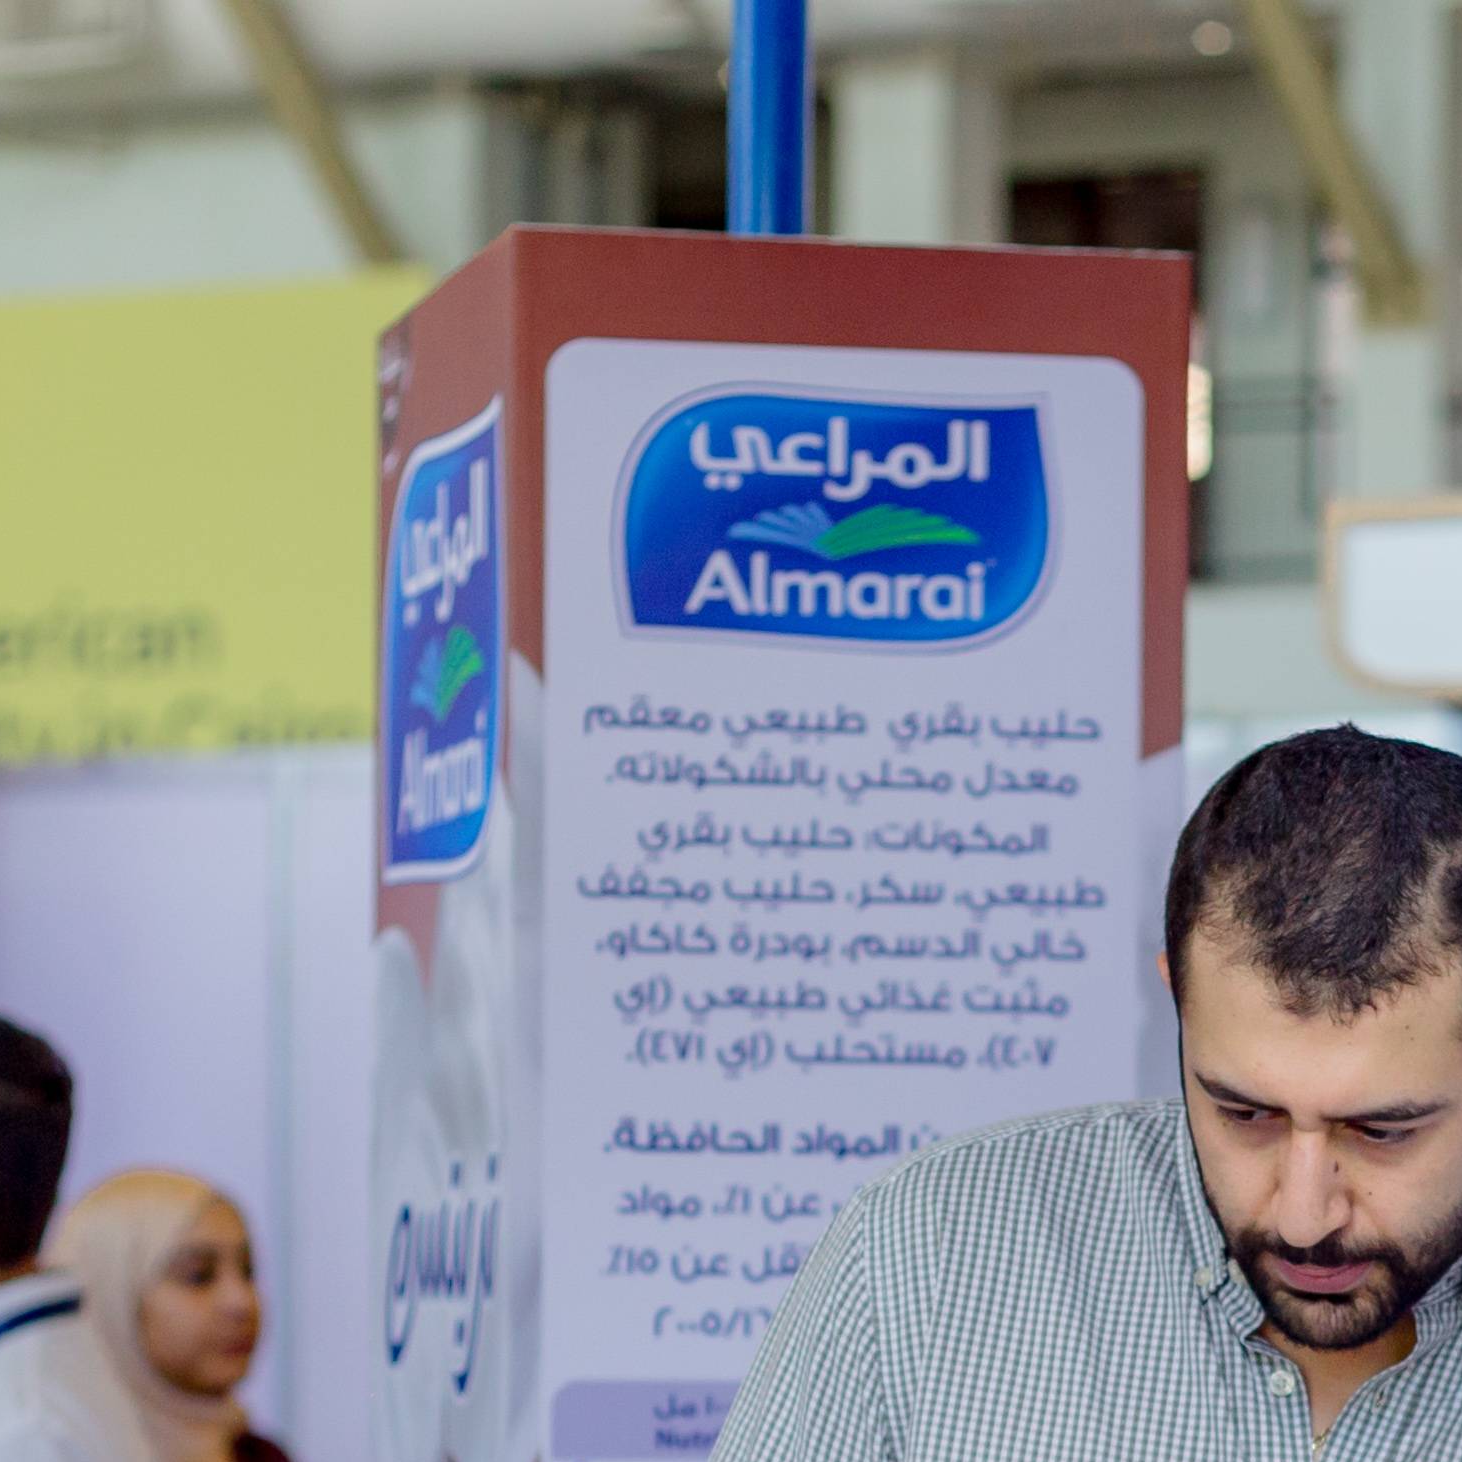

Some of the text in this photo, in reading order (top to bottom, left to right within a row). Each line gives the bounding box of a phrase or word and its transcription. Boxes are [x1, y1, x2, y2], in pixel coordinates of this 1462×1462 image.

[690, 417, 990, 501] المراعي
[685, 549, 984, 621] Almarai
[585, 695, 1102, 751] حليب بقري طبيعي معقم
[963, 761, 1078, 798] معدل
[637, 811, 730, 862] بقري
[741, 818, 853, 857] حليب
[577, 864, 711, 909] مجفف
[724, 870, 834, 912] حليب
[730, 922, 832, 966] بودرة
[992, 928, 1087, 975] خالي
[683, 980, 828, 1025] طبيعي
[962, 977, 1070, 1023] مثبت
[786, 1034, 967, 1072] مستحلب
[793, 1122, 901, 1162] المواد
[619, 1185, 701, 1221] مواد
[763, 1185, 821, 1223] عن
[671, 1245, 730, 1284] عن
